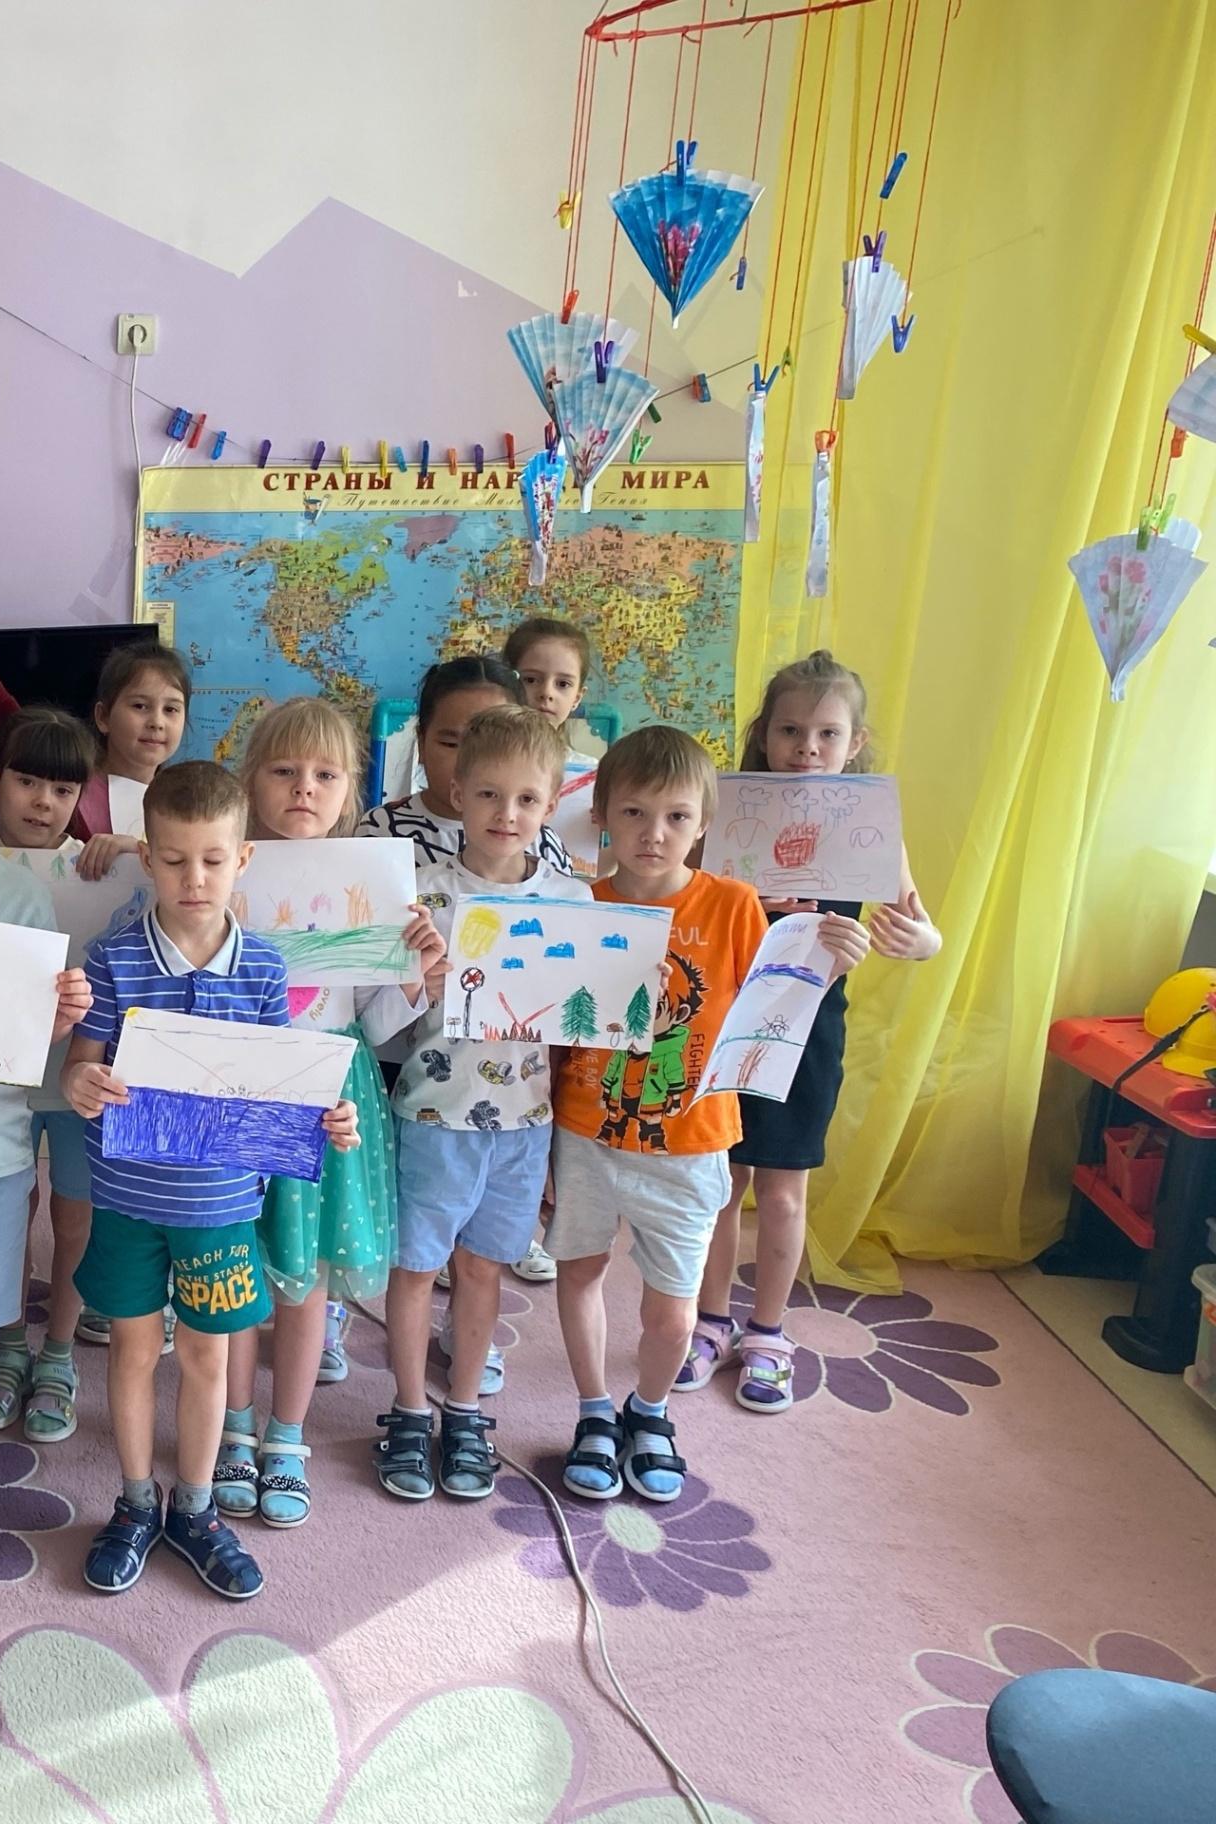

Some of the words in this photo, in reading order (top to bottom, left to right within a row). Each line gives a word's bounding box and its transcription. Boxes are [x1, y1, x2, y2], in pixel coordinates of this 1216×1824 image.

[262, 470, 392, 491] СТРАНЫ
[416, 471, 436, 490] И
[460, 469, 596, 490] НАР
[621, 469, 710, 490] МИРА
[308, 986, 331, 1022] ovely
[176, 1264, 258, 1315] SPACE
